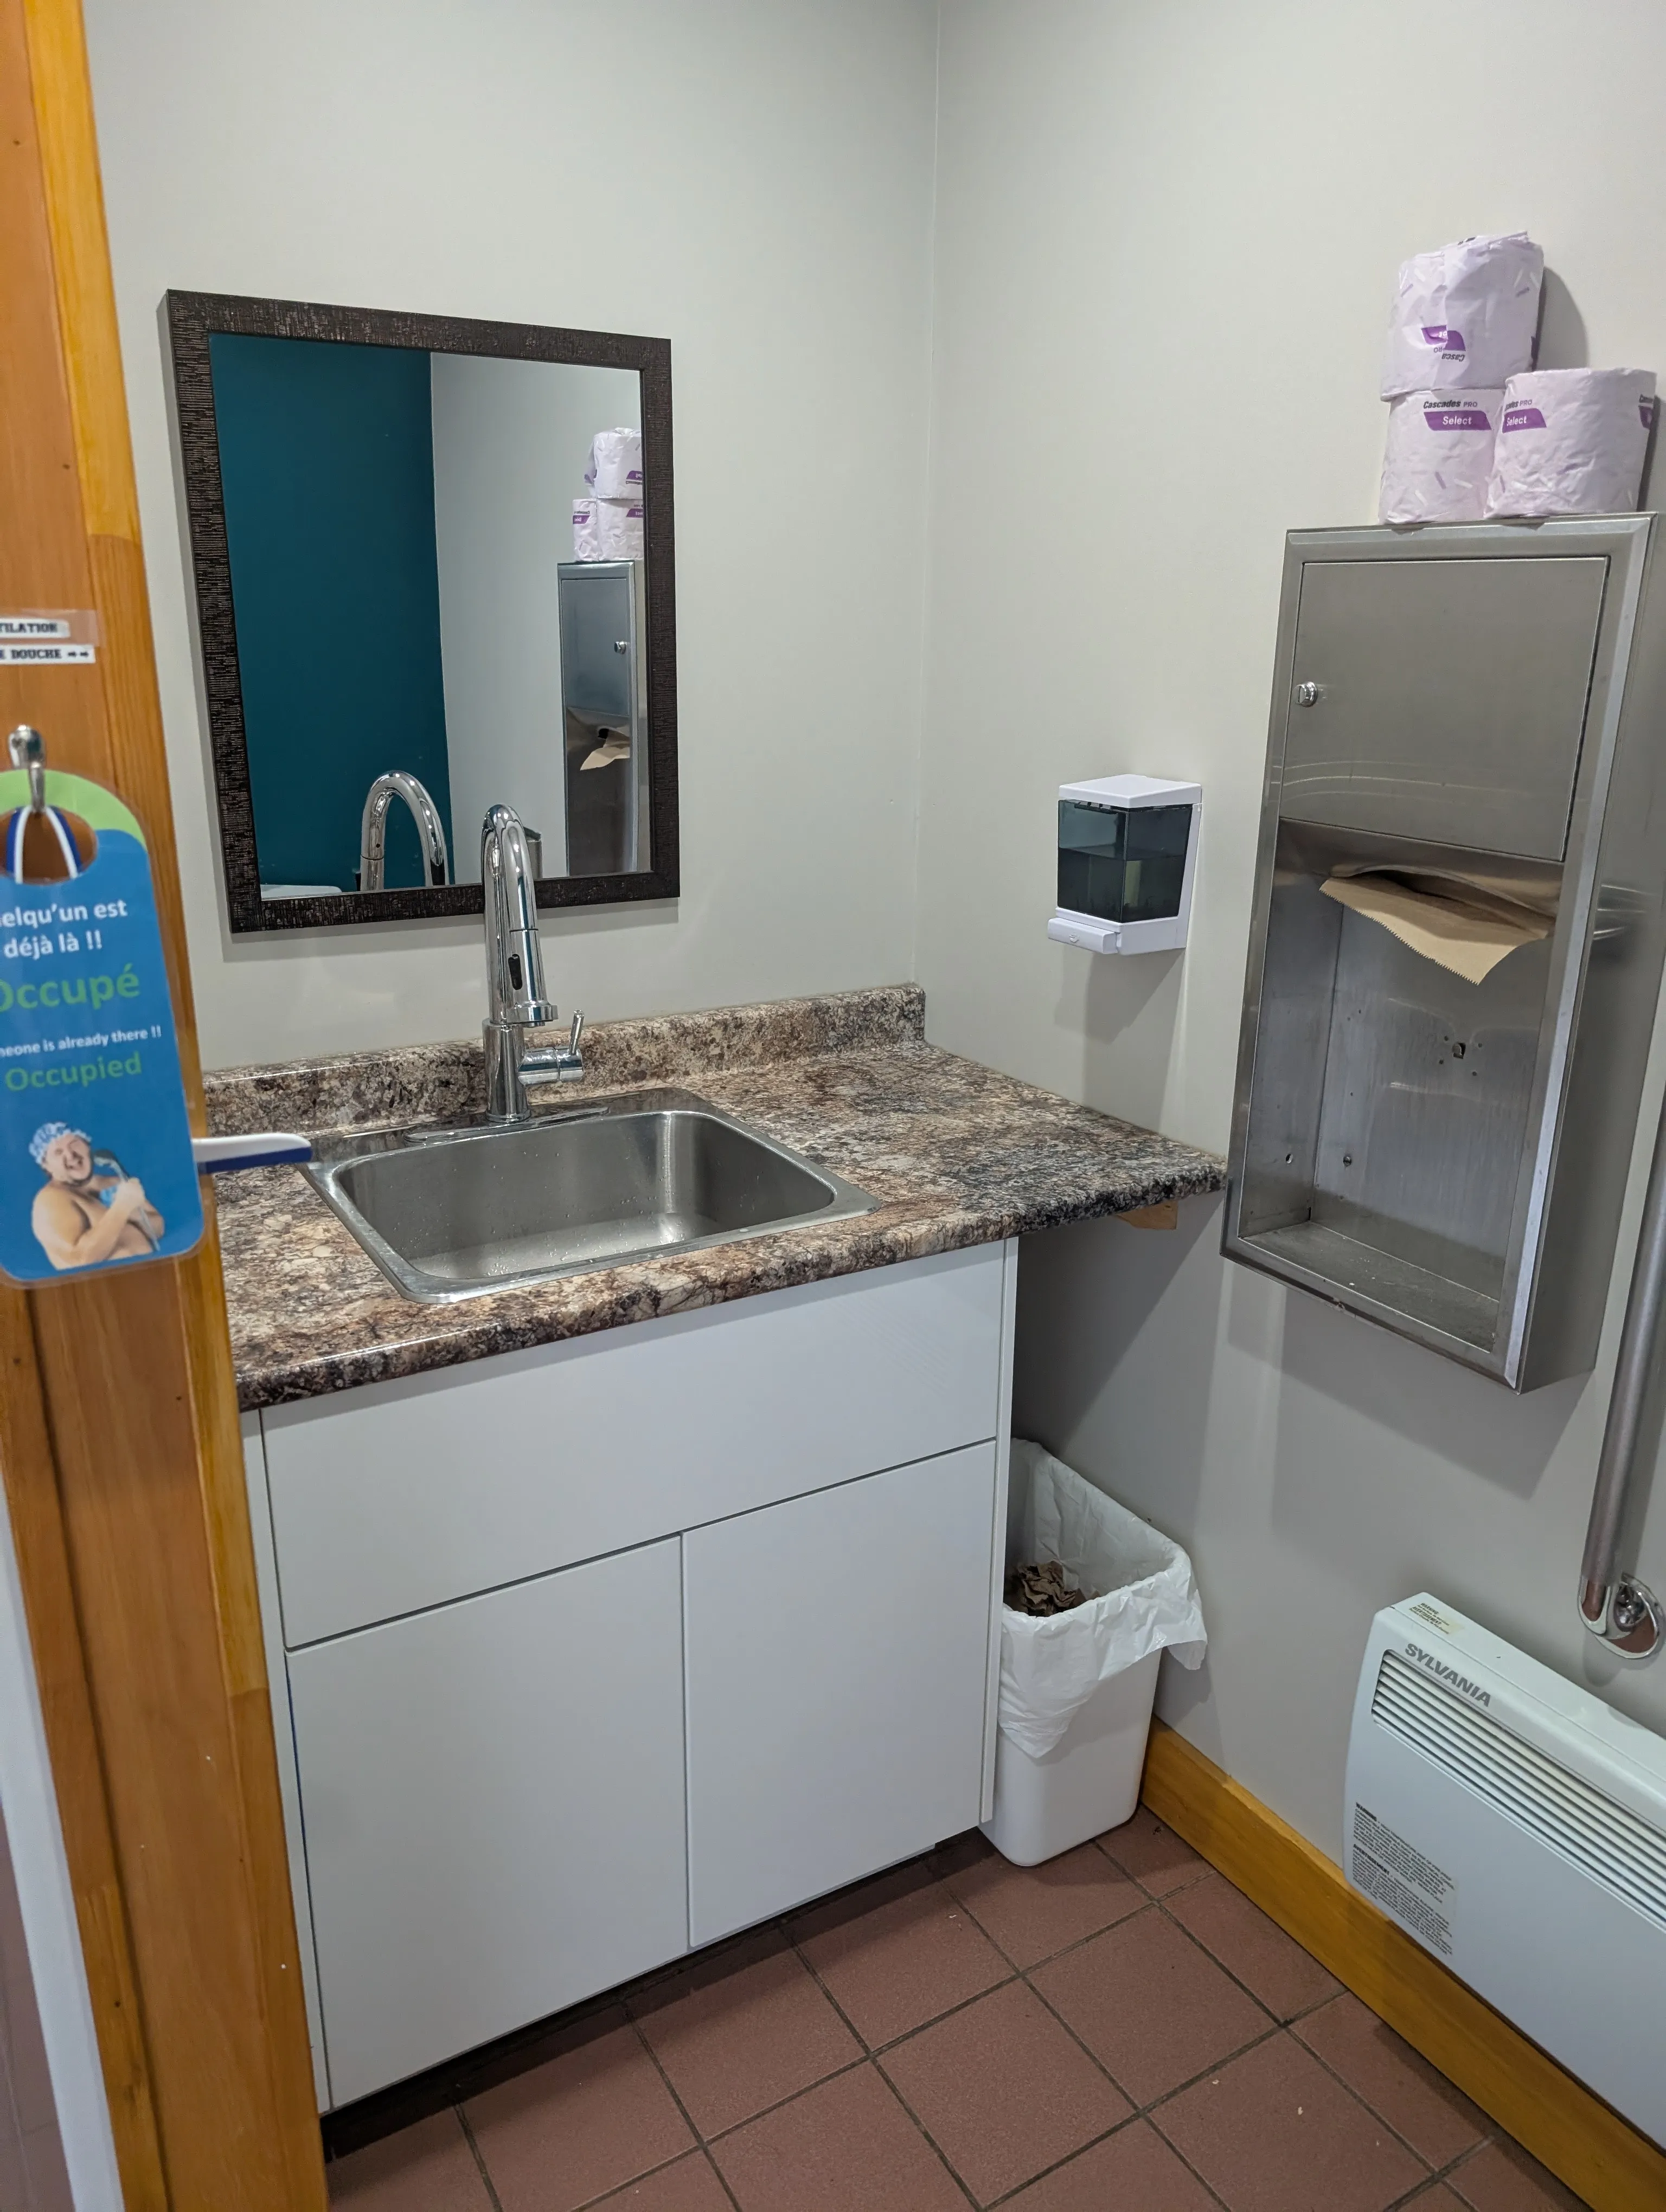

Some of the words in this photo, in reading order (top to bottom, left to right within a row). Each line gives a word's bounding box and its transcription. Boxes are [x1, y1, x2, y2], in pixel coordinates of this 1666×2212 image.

[1424, 400, 1461, 409] Cascades
[1443, 415, 1472, 425] Select
[1506, 416, 1527, 427] Select
[11, 649, 62, 659] DOUCHE
[0, 903, 88, 929] elqu'un
[93, 899, 128, 919] est
[3, 934, 54, 960] déjà
[58, 931, 80, 953] là
[85, 929, 102, 950] !!
[42, 1038, 55, 1052] is
[58, 1033, 109, 1051] already
[110, 1029, 149, 1043] there
[5, 1051, 142, 1092] Occupied
[1405, 1643, 1491, 1707] SYLVANIA
